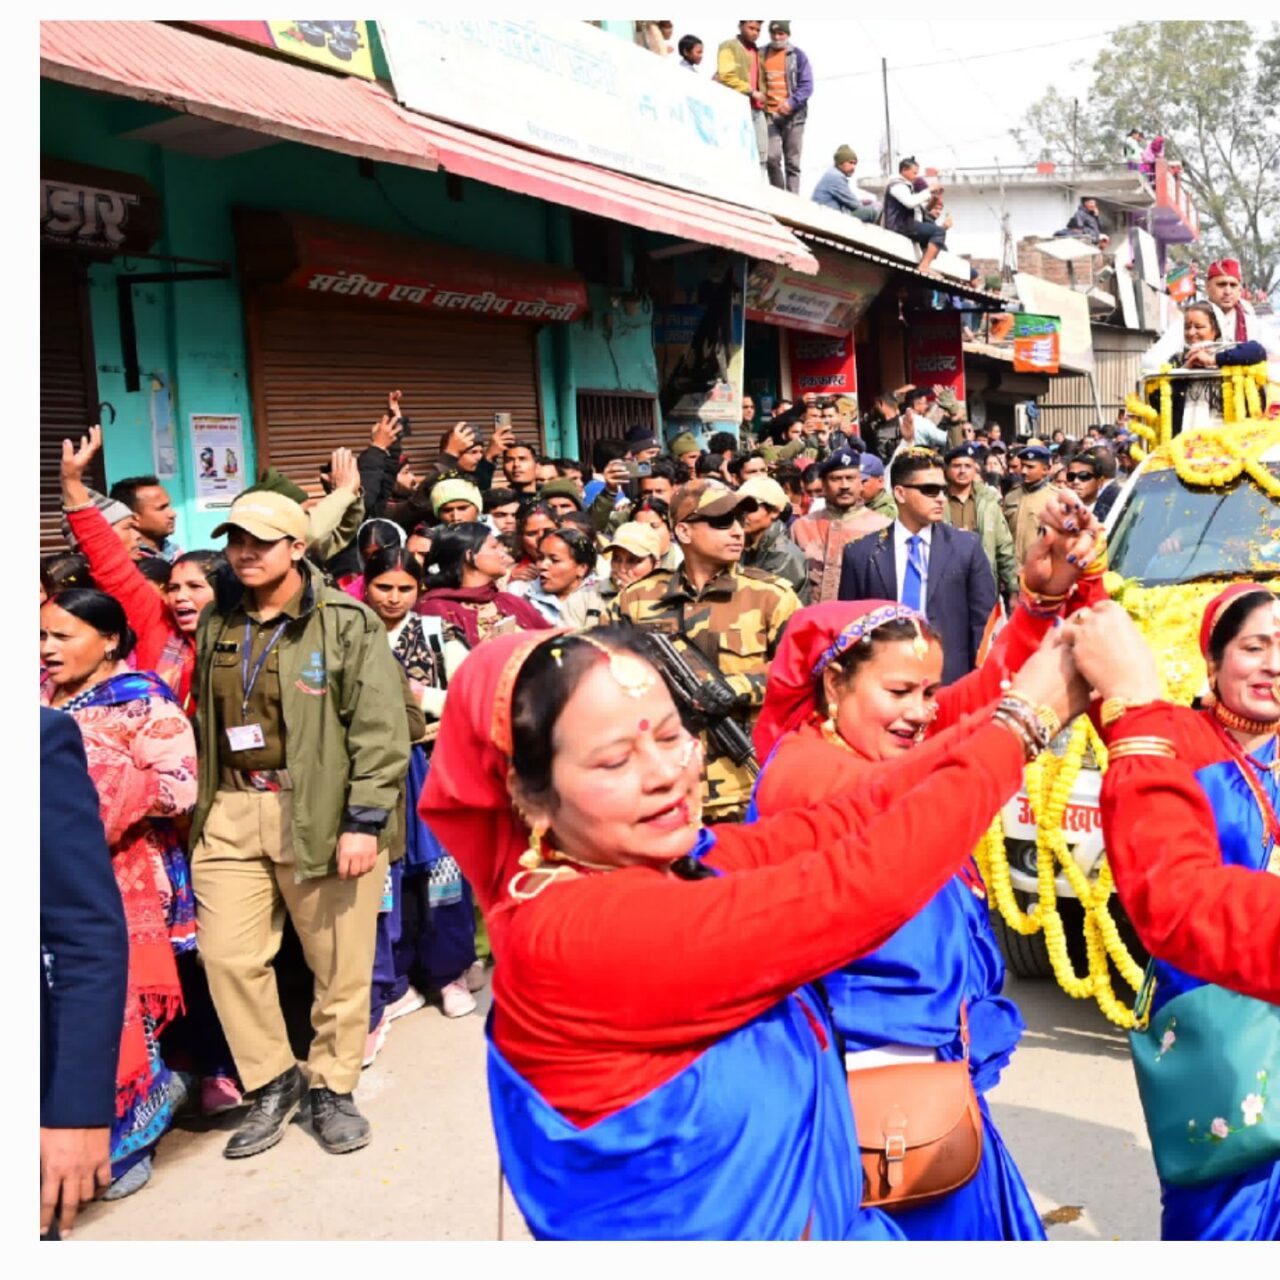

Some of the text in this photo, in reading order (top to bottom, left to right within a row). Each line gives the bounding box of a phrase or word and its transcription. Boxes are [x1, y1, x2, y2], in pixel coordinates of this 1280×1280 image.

[308, 271, 388, 298] संदीप
[389, 283, 435, 304] एवं
[431, 290, 512, 314] बलदीप
